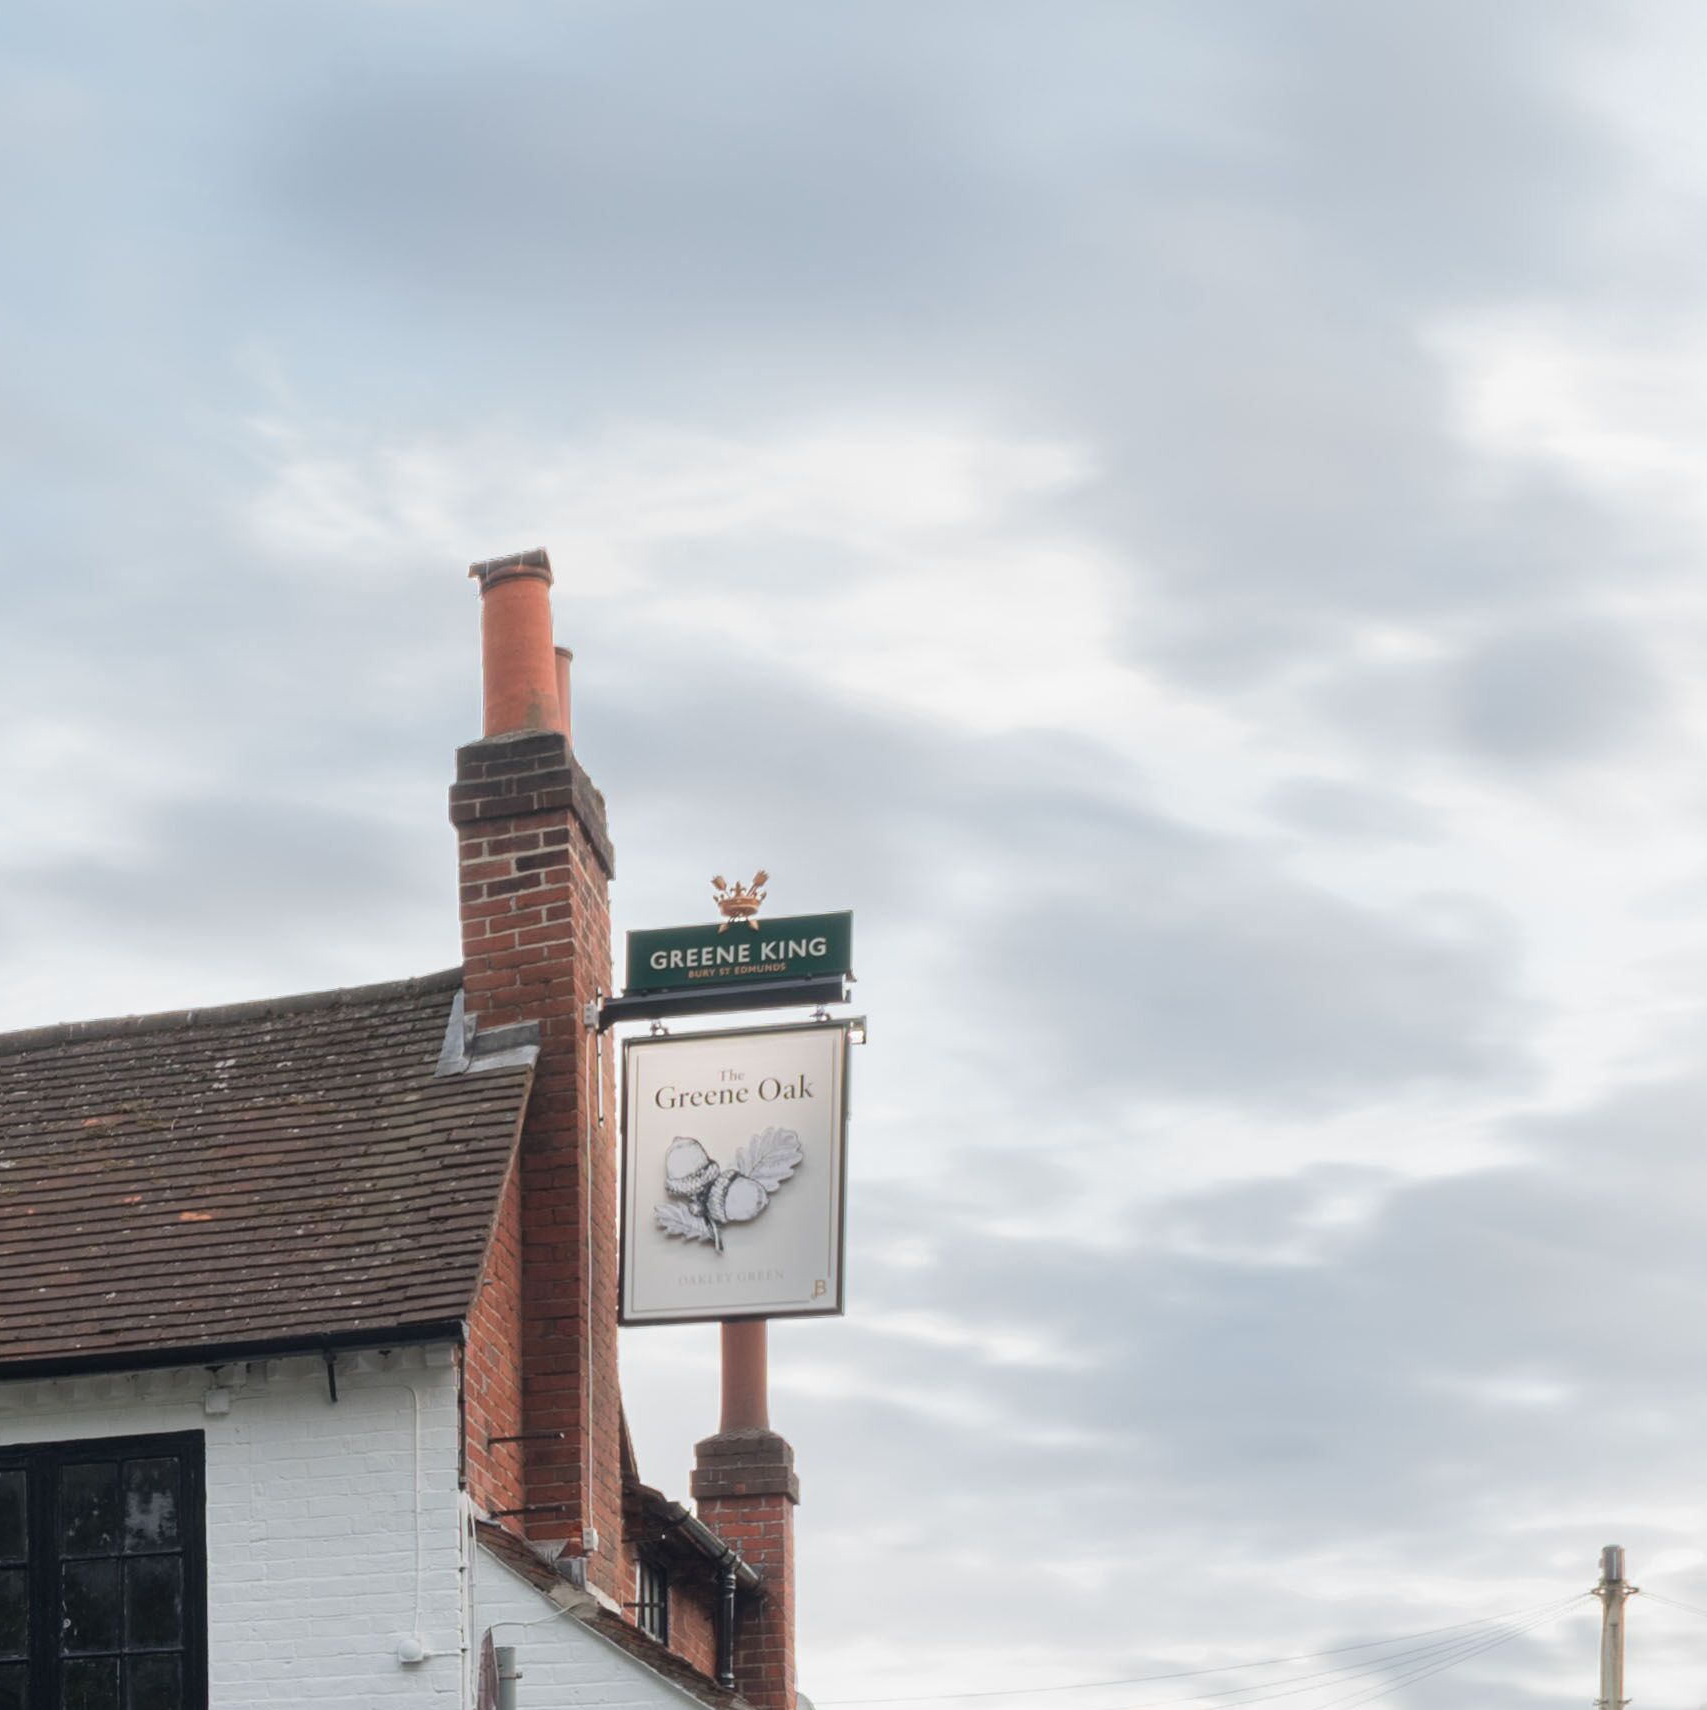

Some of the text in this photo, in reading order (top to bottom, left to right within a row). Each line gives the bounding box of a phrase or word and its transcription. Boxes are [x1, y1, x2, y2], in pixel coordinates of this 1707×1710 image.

[650, 937, 827, 970] GREENE KING
[688, 962, 787, 979] BURY ST EDMUNDS
[719, 1069, 746, 1082] The
[654, 1073, 815, 1110] Greene Oak
[678, 1269, 785, 1287] OAKLEY GREEN
